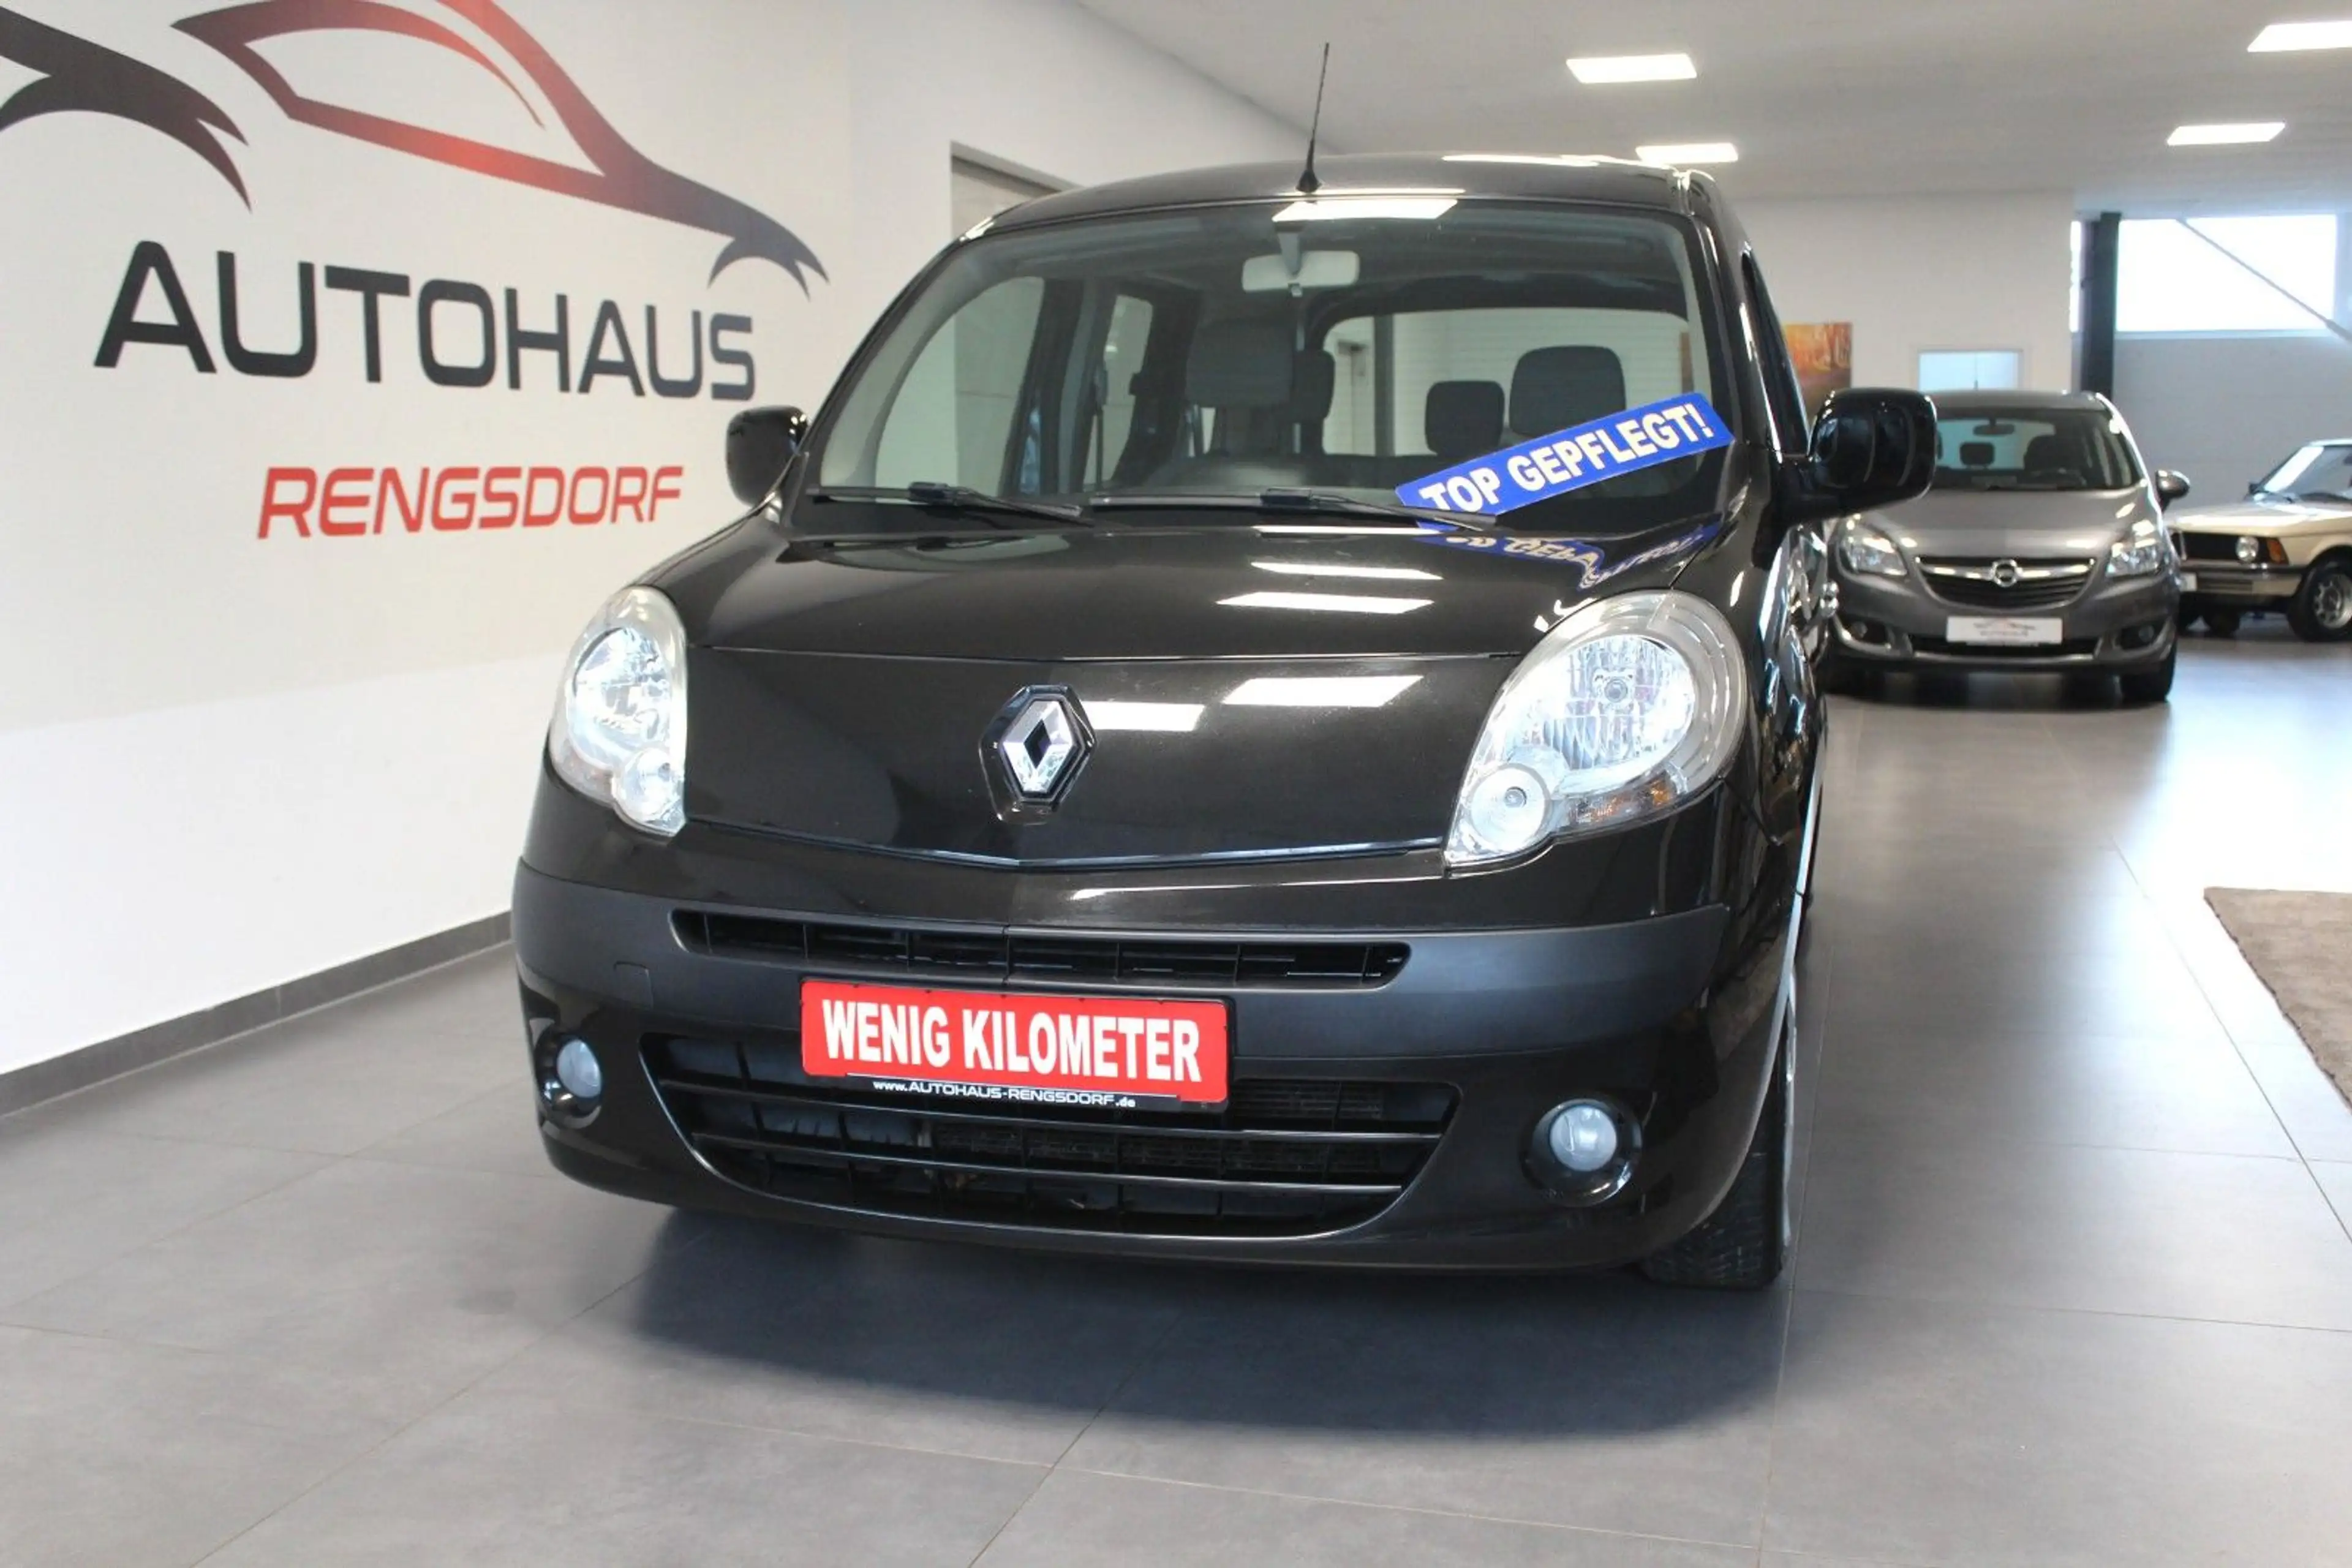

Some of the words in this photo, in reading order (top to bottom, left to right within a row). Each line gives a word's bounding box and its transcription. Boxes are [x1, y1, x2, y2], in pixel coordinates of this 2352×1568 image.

[94, 240, 755, 401] AUTOHAUS
[1419, 467, 1501, 513] TOP
[1507, 402, 1714, 491] GEPFLEGT!
[257, 466, 684, 539] RENGSDORF
[822, 999, 951, 1068] WENIG
[962, 1008, 1202, 1083] KILOMETER
[873, 1080, 1136, 1108] www.AUTOHAUS-RENGSDORF.de
